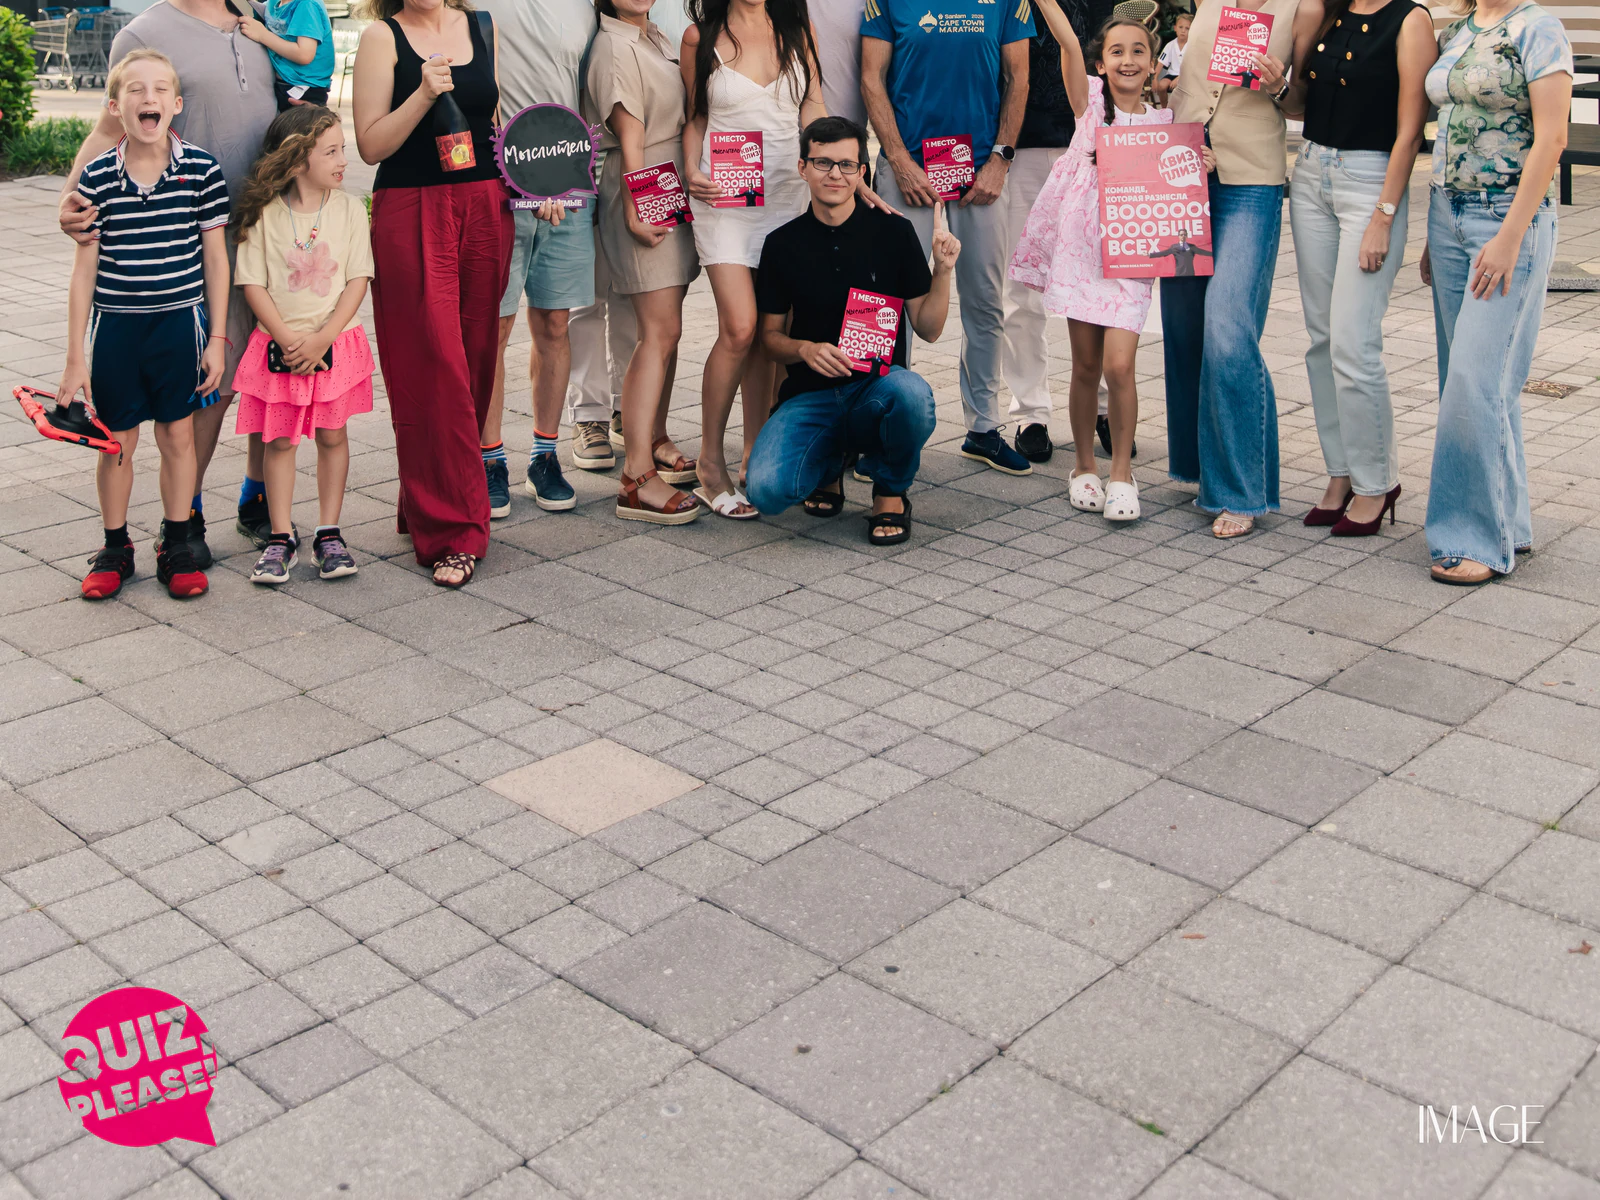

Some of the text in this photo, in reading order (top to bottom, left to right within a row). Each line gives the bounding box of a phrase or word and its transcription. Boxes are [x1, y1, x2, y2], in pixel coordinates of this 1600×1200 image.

[1229, 10, 1257, 22] МЕСТО
[1211, 62, 1238, 74] ВСЕХ
[930, 139, 956, 148] МЕСТО
[1103, 131, 1169, 147] 1 МЕСТО
[504, 140, 591, 165] Мыслитель
[633, 169, 660, 181] МЕСТО
[1161, 162, 1201, 181] ПЛИЗ!
[721, 188, 740, 197] СЕХ
[933, 184, 953, 193] СЕХ
[1105, 185, 1148, 194] КОМАНДЕ,
[1106, 193, 1188, 203] КОТОРАЯ РАЗНЕСЛА
[643, 212, 668, 224] ВСЕХ
[1108, 238, 1161, 256] ВСЕХ
[857, 293, 886, 305] МЕСТО
[841, 346, 867, 359] ВСЕХ
